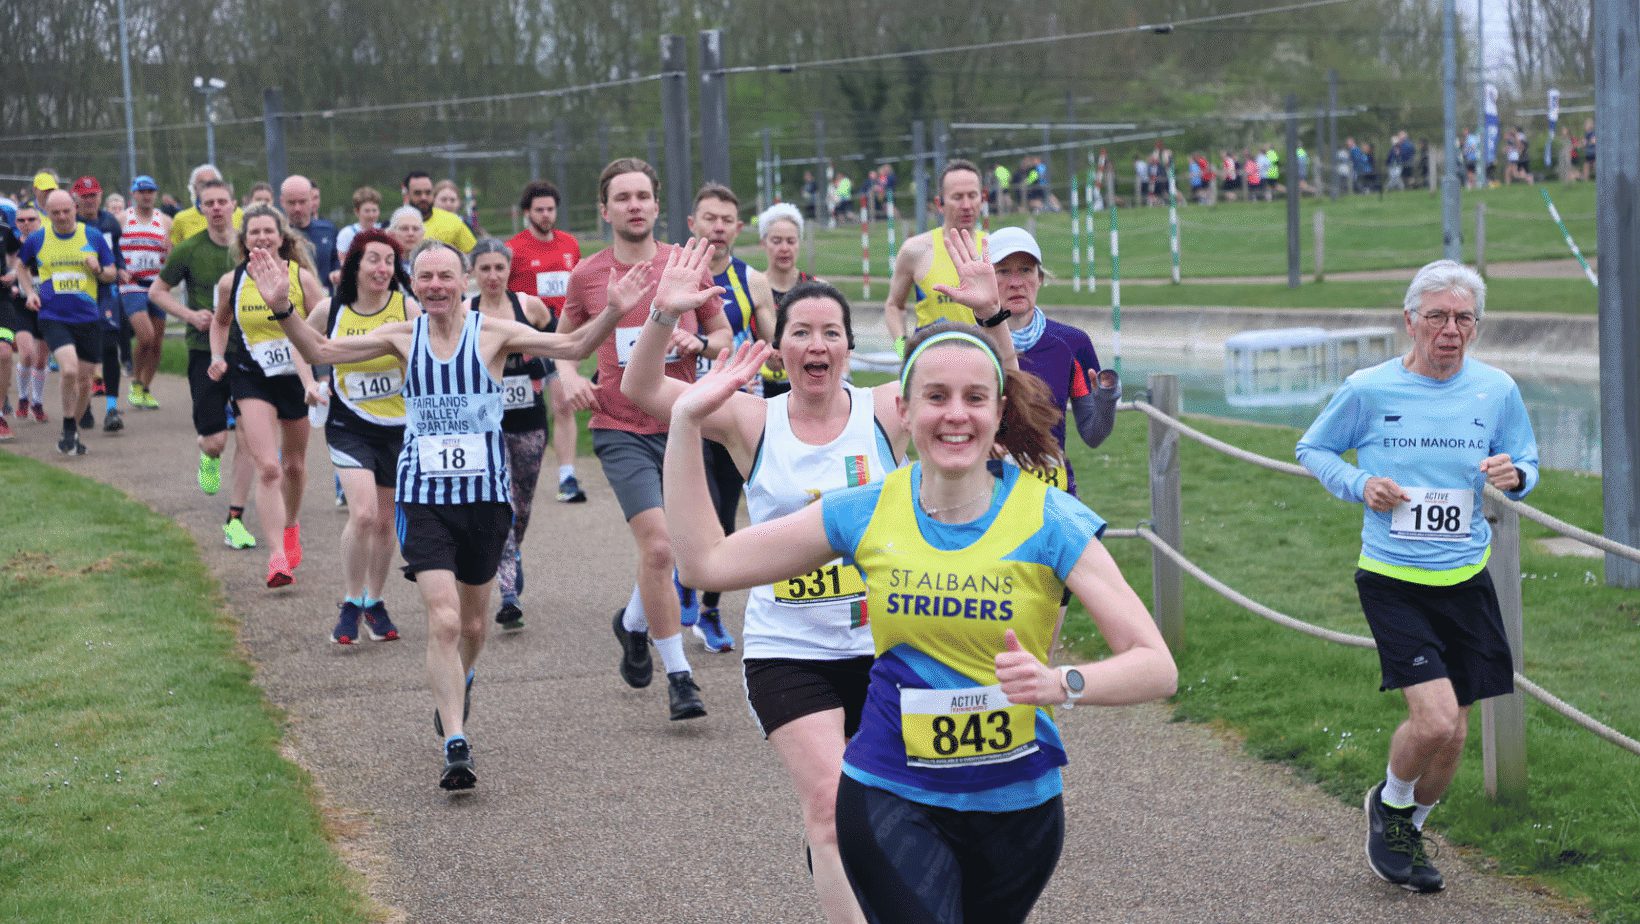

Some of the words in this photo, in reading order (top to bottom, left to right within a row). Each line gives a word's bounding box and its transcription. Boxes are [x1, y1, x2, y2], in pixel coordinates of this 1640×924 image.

[264, 347, 291, 366] 361
[358, 377, 391, 396] 140
[412, 396, 468, 409] FAIRLANDS
[419, 408, 460, 420] VALLEY
[416, 420, 469, 432] SPARTANS
[1383, 438, 1417, 448] ETON
[1420, 438, 1466, 449] MANOR
[438, 448, 466, 469] 18
[1424, 492, 1449, 501] ACTIVE
[1410, 504, 1461, 532] 198
[788, 565, 841, 599] 531
[889, 568, 912, 588] ST
[916, 571, 1014, 595] ALBANS
[886, 592, 1014, 622] STRIDERS
[950, 694, 989, 708] ACTIVE
[931, 710, 1013, 756] 843
